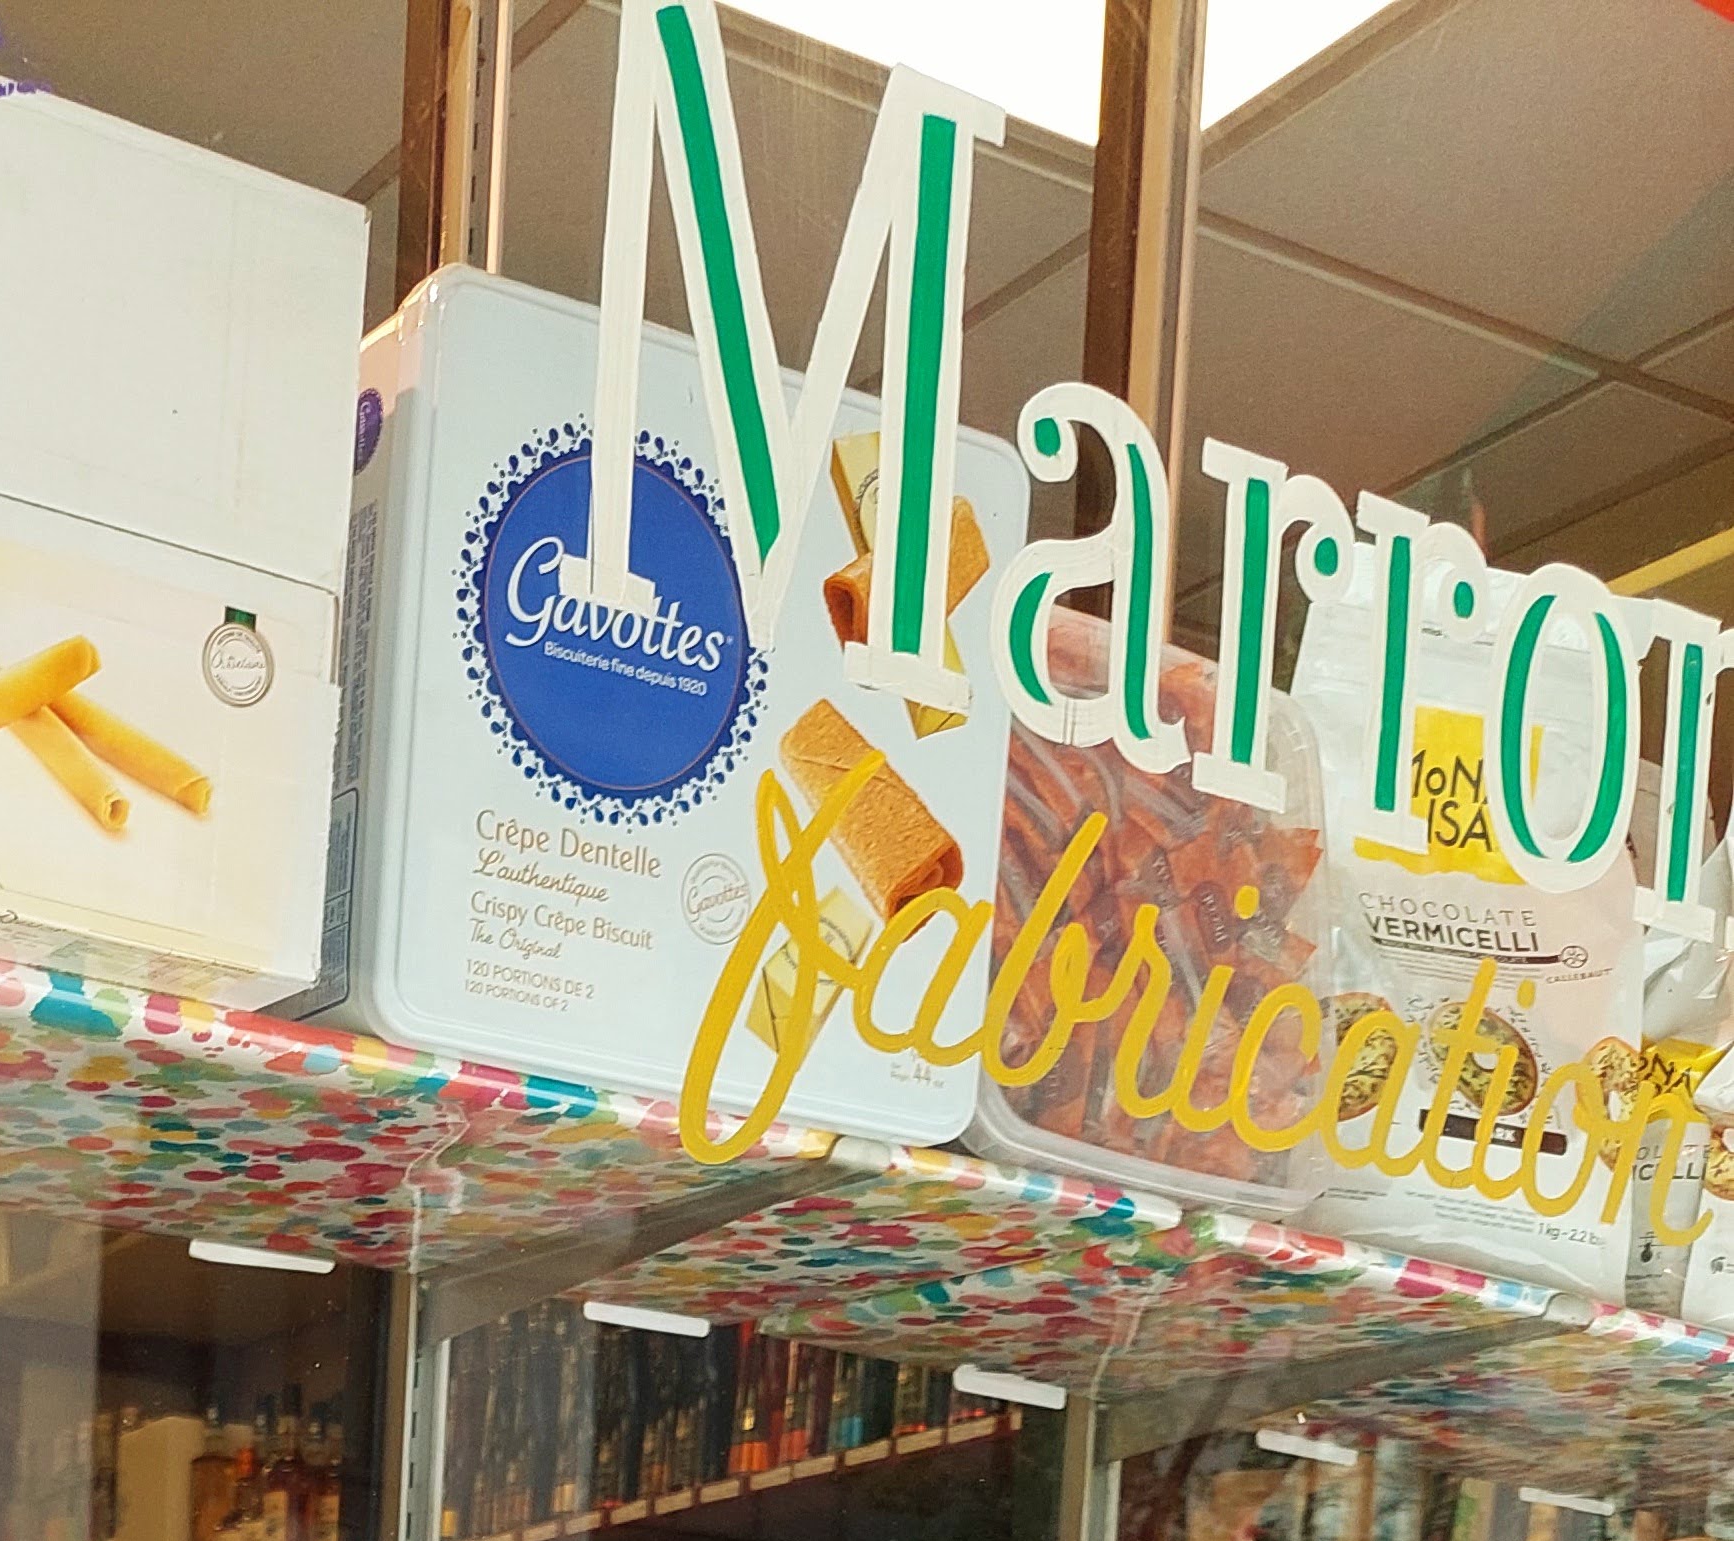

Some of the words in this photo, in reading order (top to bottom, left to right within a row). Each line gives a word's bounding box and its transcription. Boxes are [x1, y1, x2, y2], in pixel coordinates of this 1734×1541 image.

[505, 536, 726, 672] Gavottes
[544, 641, 610, 673] Biscuiterie
[611, 658, 635, 678] fine
[636, 667, 677, 690] depuis
[677, 675, 708, 697] 1920
[476, 809, 550, 854] Crêpe
[560, 828, 662, 879] Dentelle
[472, 847, 610, 907] L'authentique
[471, 890, 528, 928] Crispy
[534, 904, 587, 938] Crêpe
[592, 916, 655, 951] Biscuit
[1358, 891, 1538, 928] CHOCOLATE
[1364, 914, 1540, 953] VERMICELLI
[469, 918, 494, 945] The
[499, 928, 562, 960] Original
[484, 982, 541, 1007] PORTIONS
[493, 964, 561, 994] PORTIONS
[563, 980, 584, 997] DE
[585, 983, 595, 1000] 2
[677, 750, 1713, 1247] fabrication
